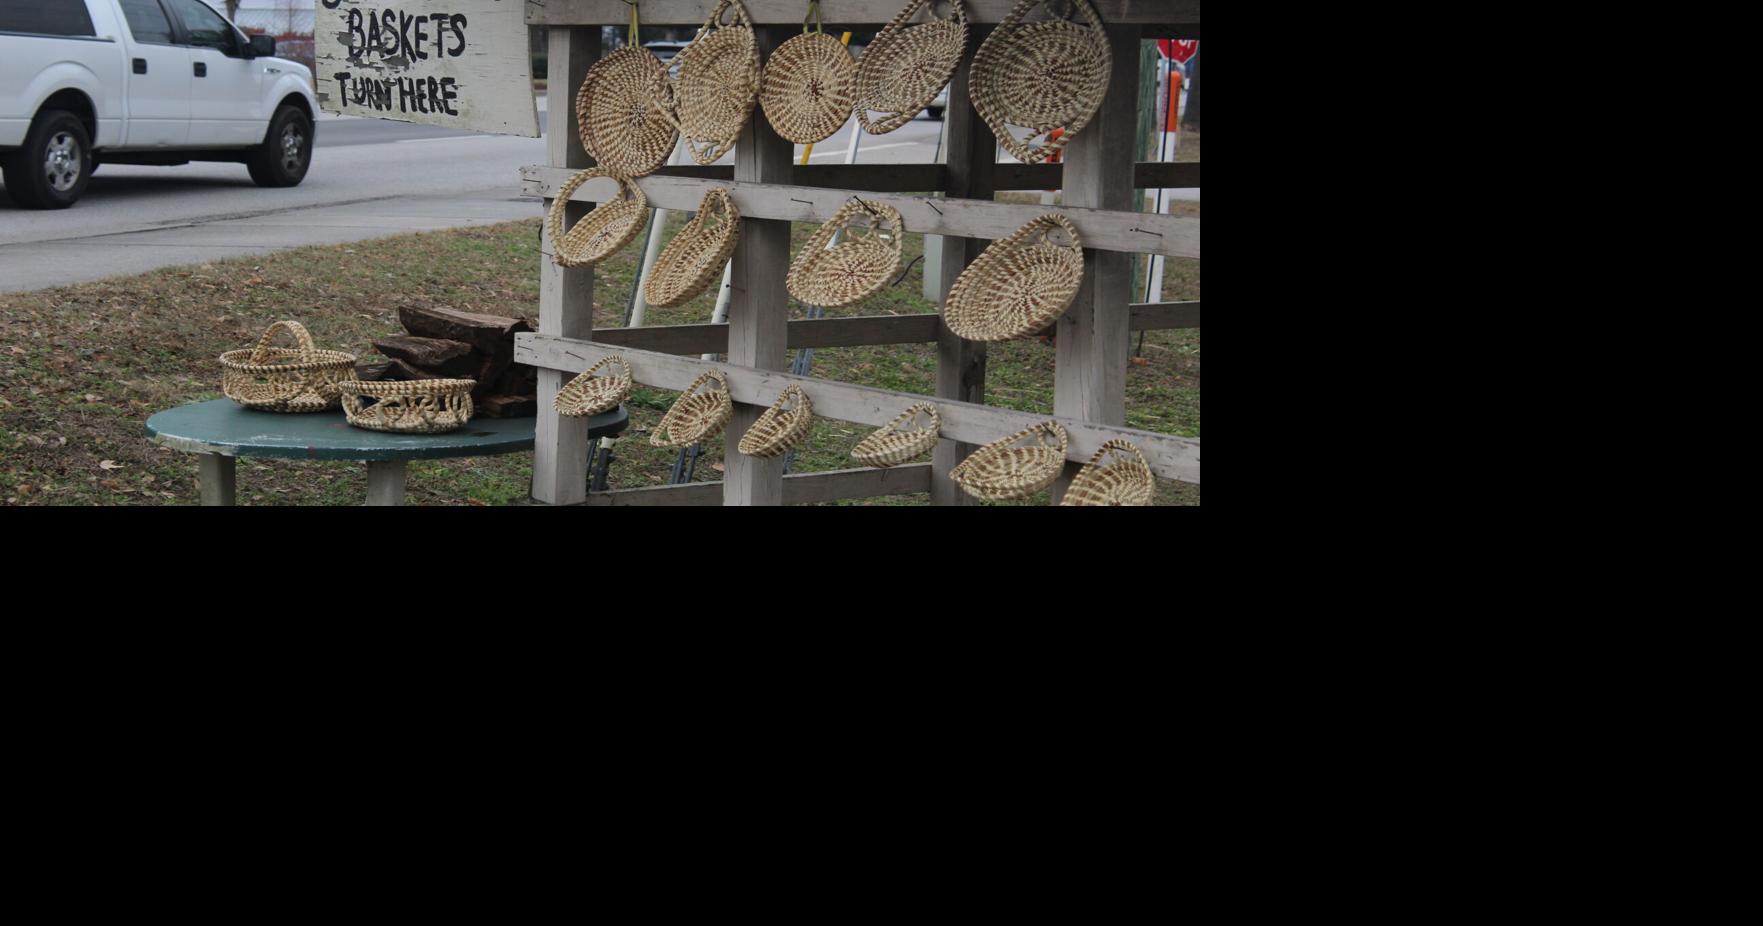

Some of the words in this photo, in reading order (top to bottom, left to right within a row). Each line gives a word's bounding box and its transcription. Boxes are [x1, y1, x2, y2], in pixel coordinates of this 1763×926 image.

[348, 8, 467, 62] BASKETS
[333, 71, 391, 111] TURN
[398, 76, 458, 116] HERE
